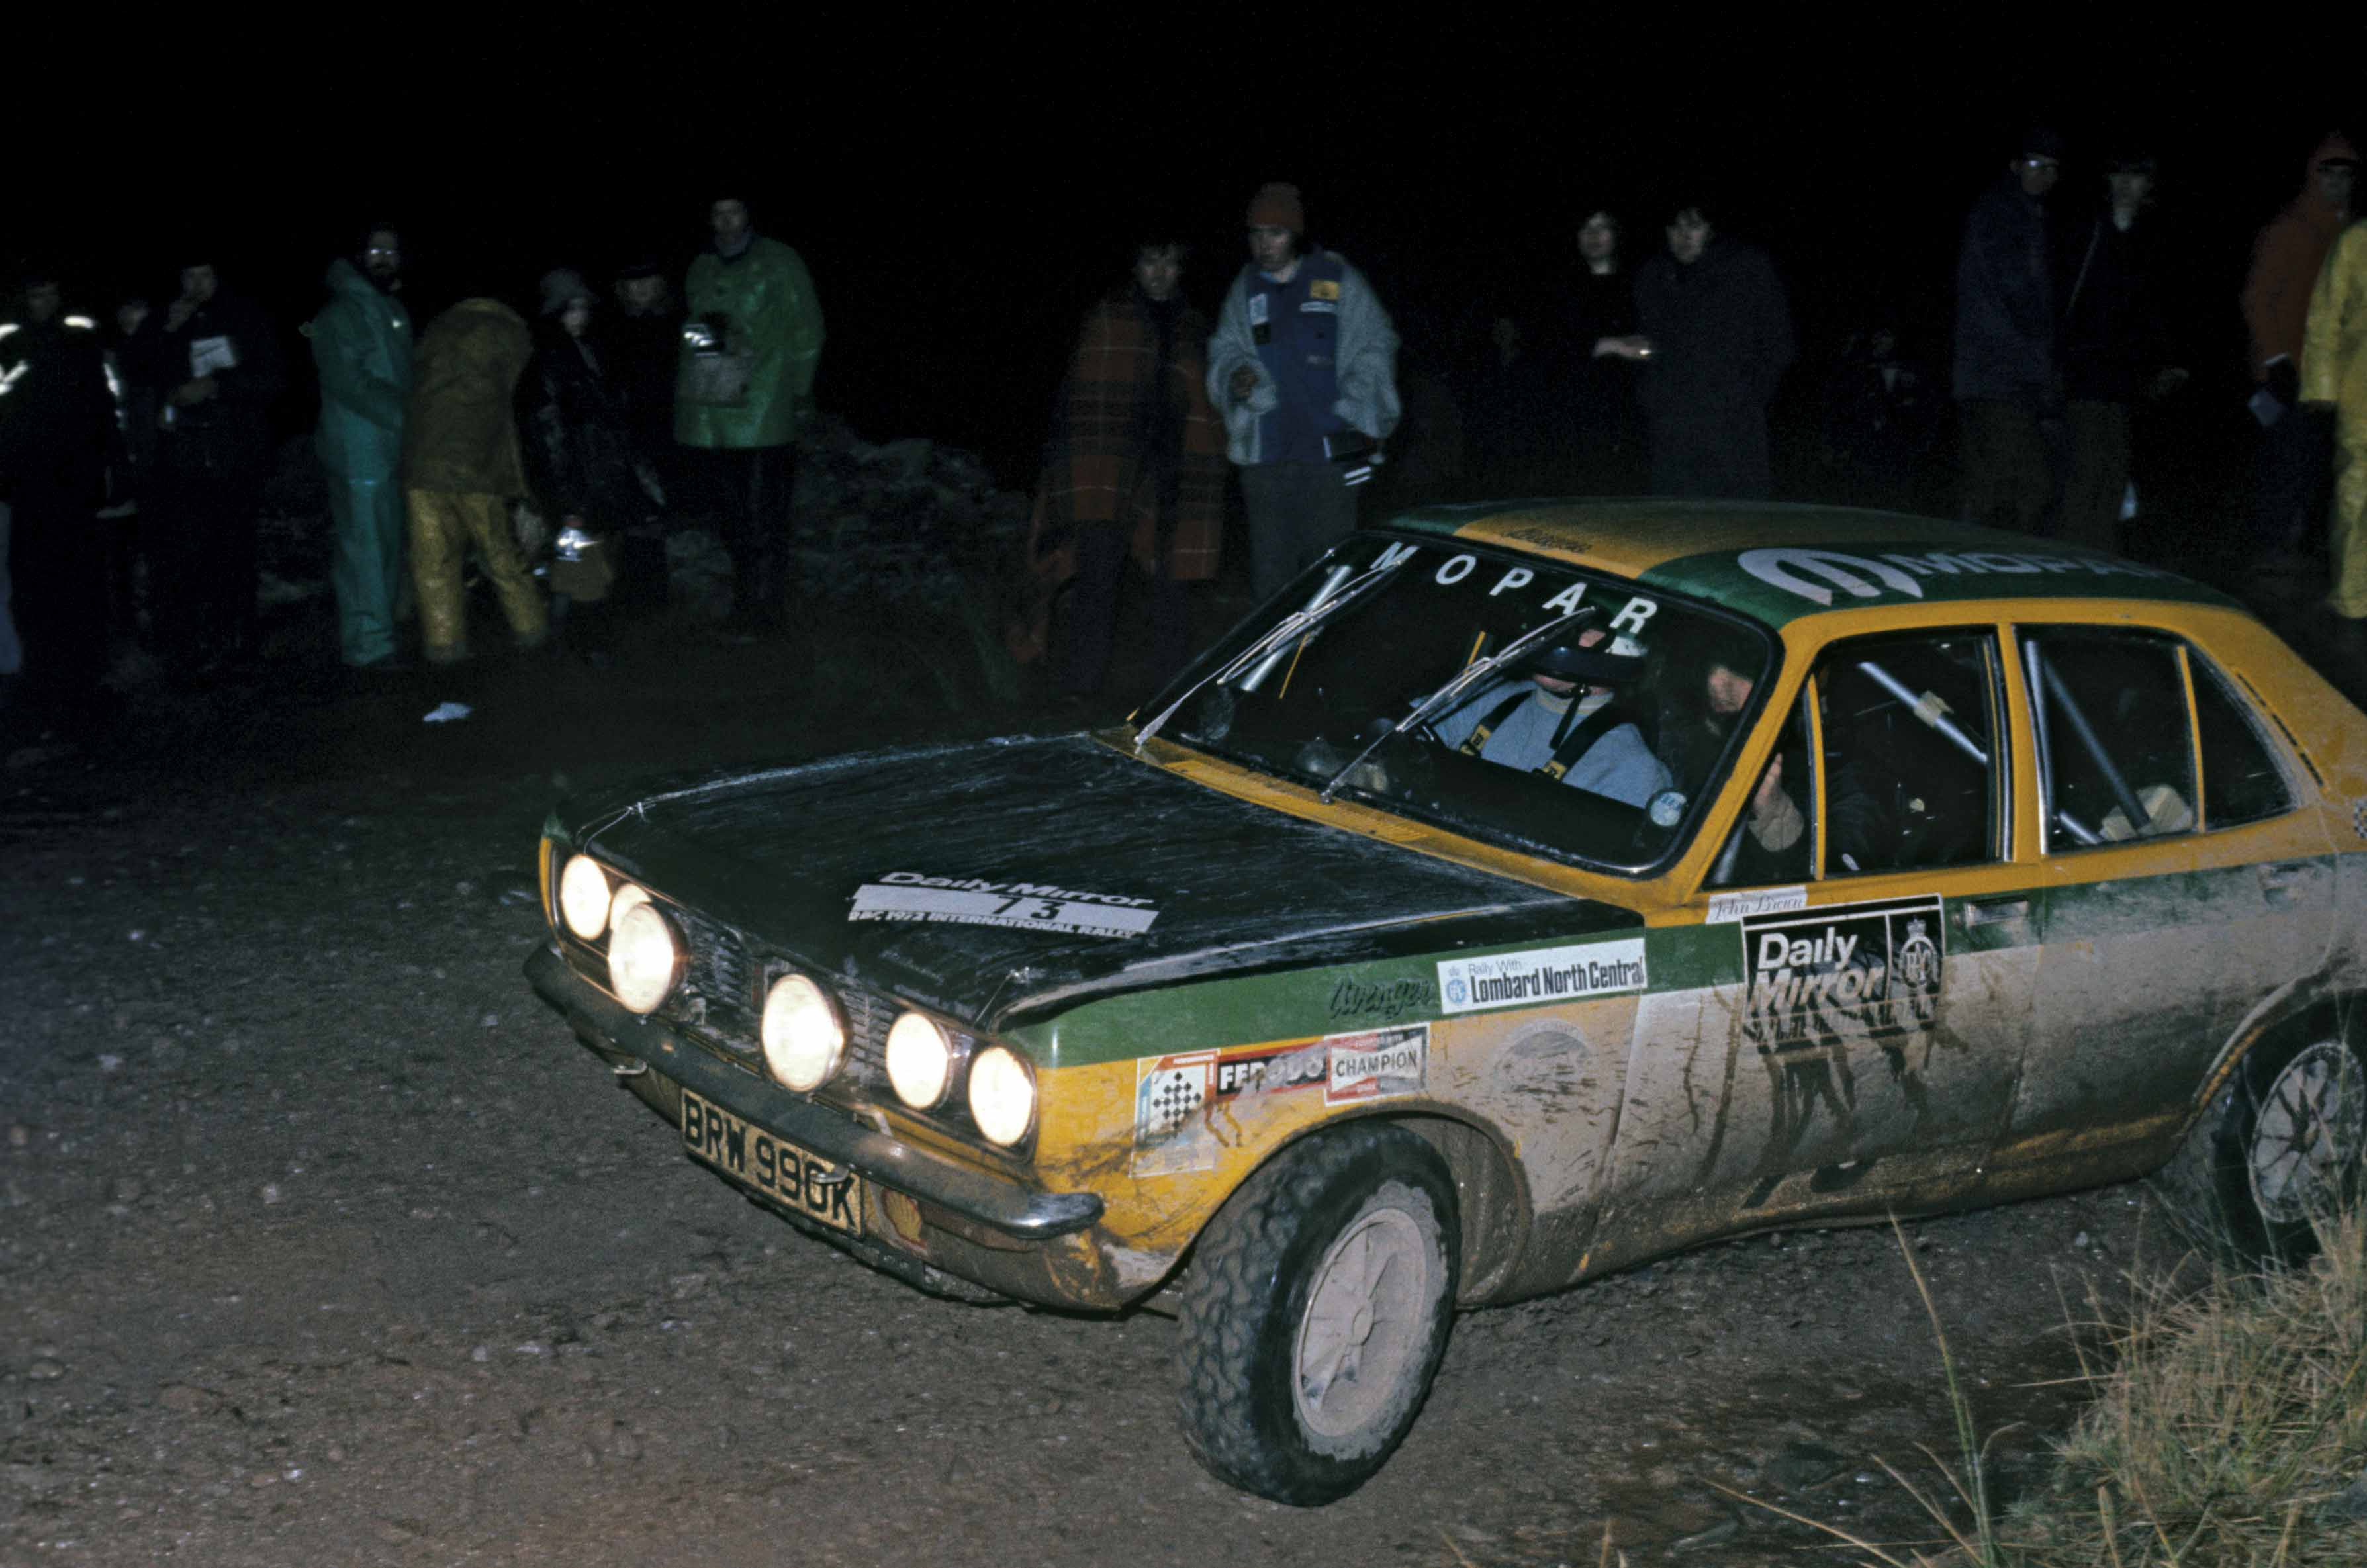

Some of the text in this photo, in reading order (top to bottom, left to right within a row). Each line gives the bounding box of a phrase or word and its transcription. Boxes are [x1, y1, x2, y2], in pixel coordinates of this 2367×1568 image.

[1879, 552, 2178, 579] MOPA
[1369, 540, 1657, 635] MOPAR
[879, 871, 1154, 907] Daily Mirror
[886, 911, 925, 922] 1972
[926, 911, 1077, 933] INTERNATIONAL
[1468, 959, 1522, 976] Rally With
[1757, 926, 1858, 971] Daily
[1470, 968, 1540, 1003] Lombard
[1542, 963, 1588, 995] North
[1589, 955, 1646, 990] Central
[1748, 966, 1887, 1013] Mirror
[1336, 1050, 1418, 1077] CHAMPION
[684, 1095, 747, 1173] BRW
